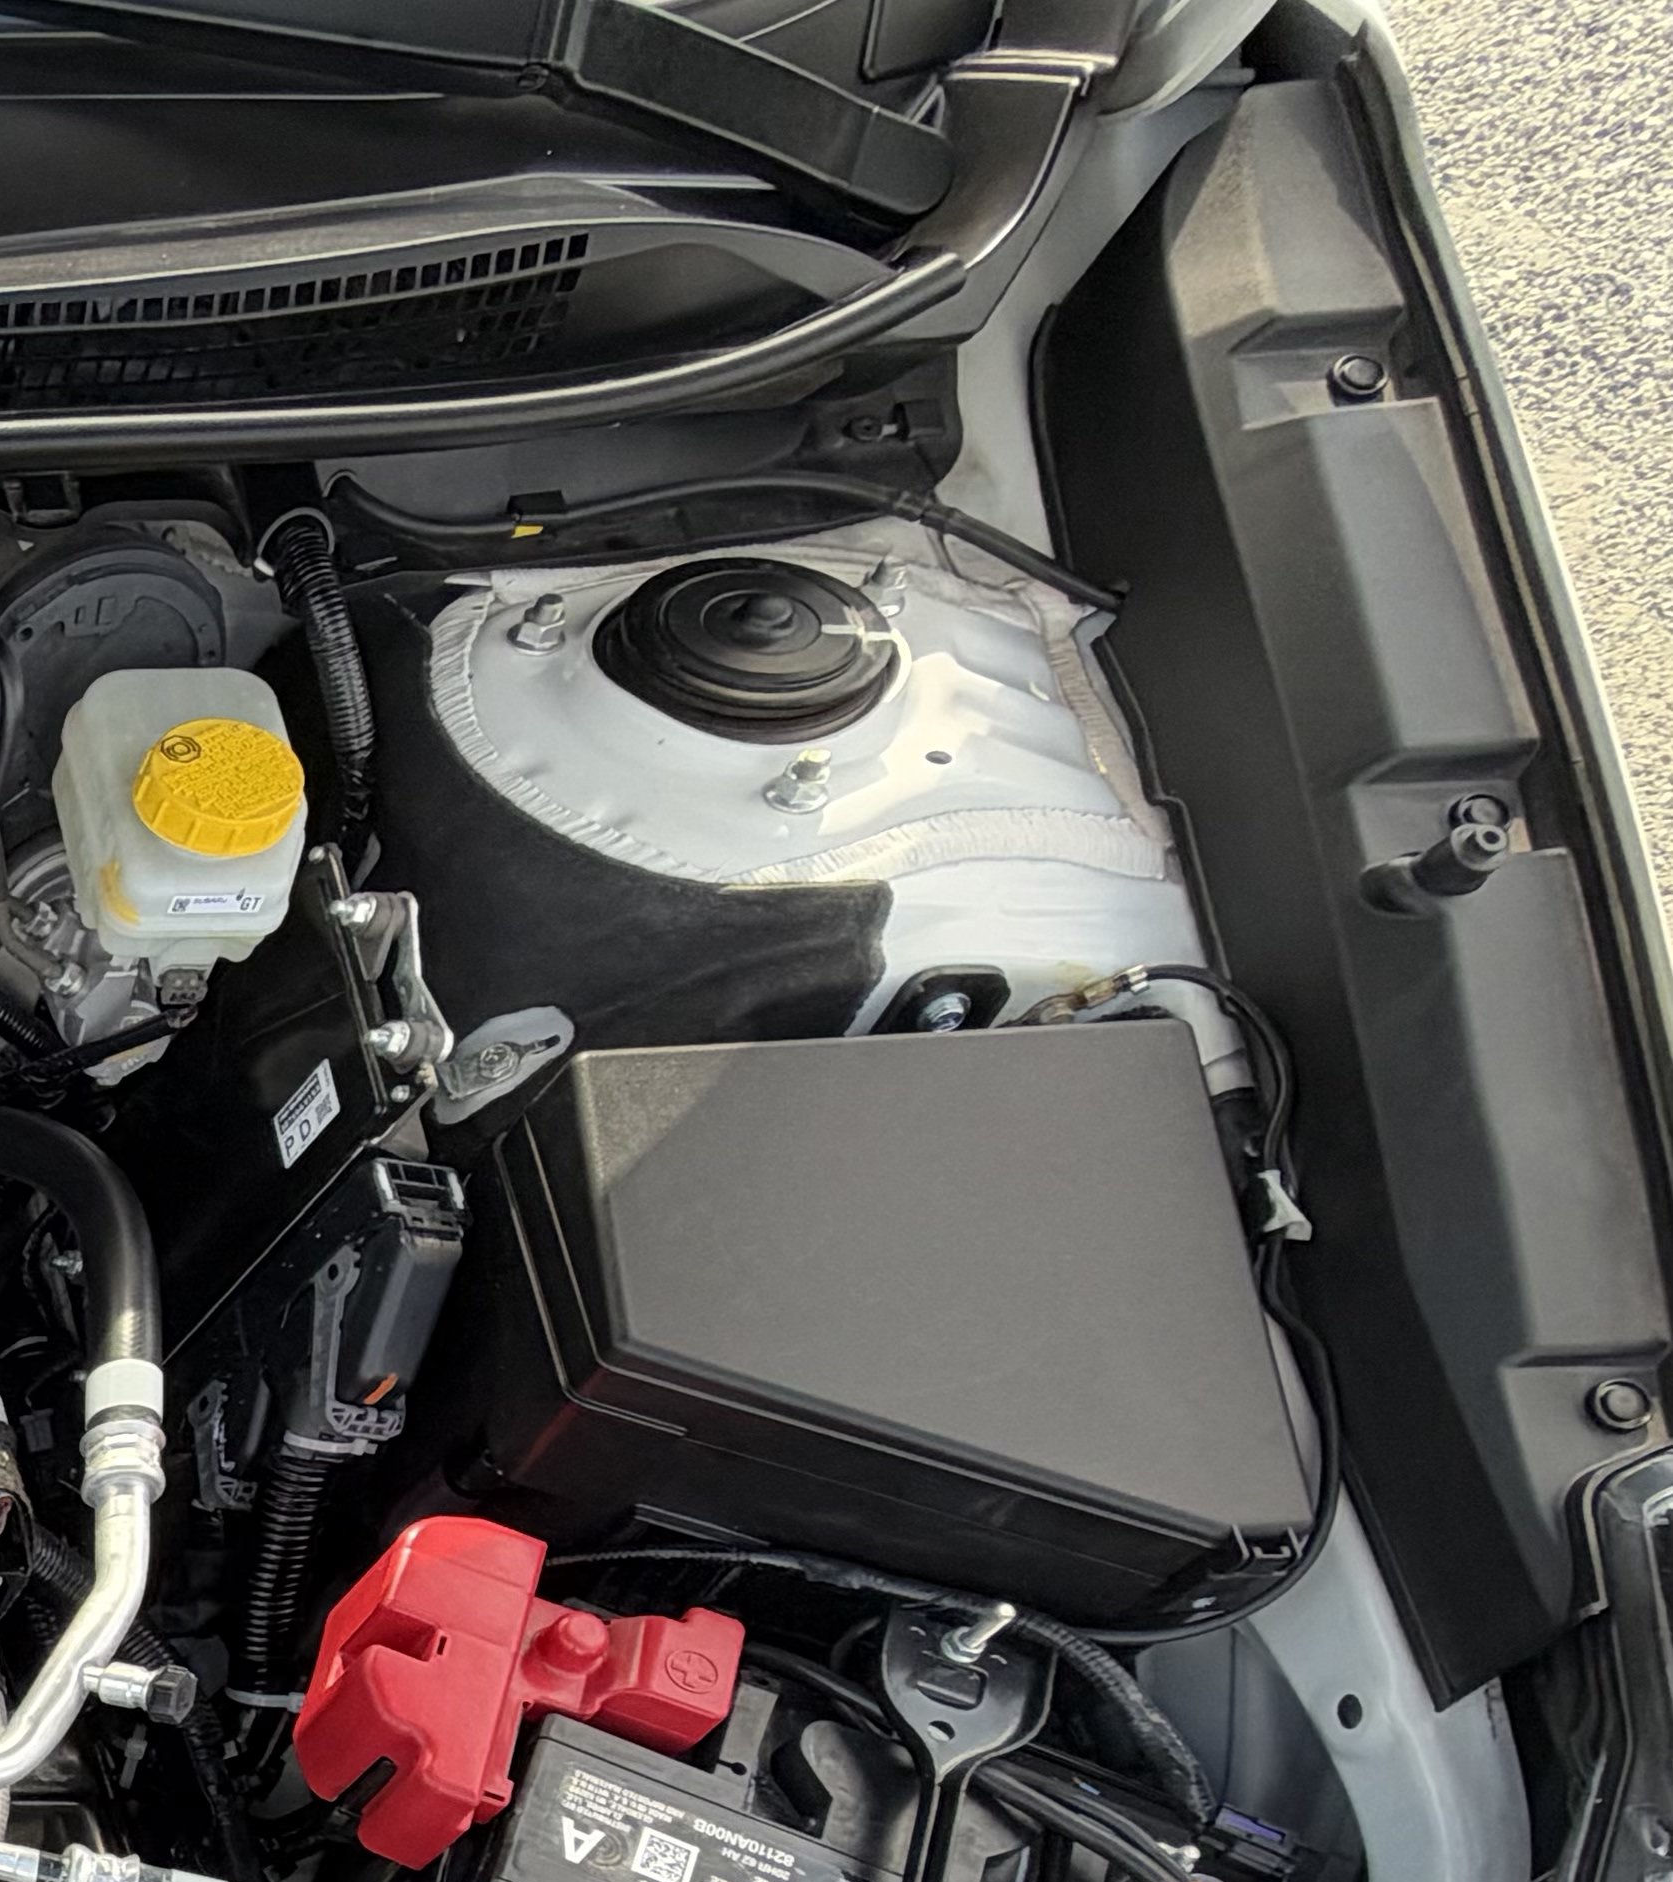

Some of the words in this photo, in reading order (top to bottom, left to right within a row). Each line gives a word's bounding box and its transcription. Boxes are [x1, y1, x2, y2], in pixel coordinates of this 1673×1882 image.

[240, 897, 262, 911] GT
[562, 1815, 606, 1864] A
[692, 1817, 796, 1867] 82110AN00B
